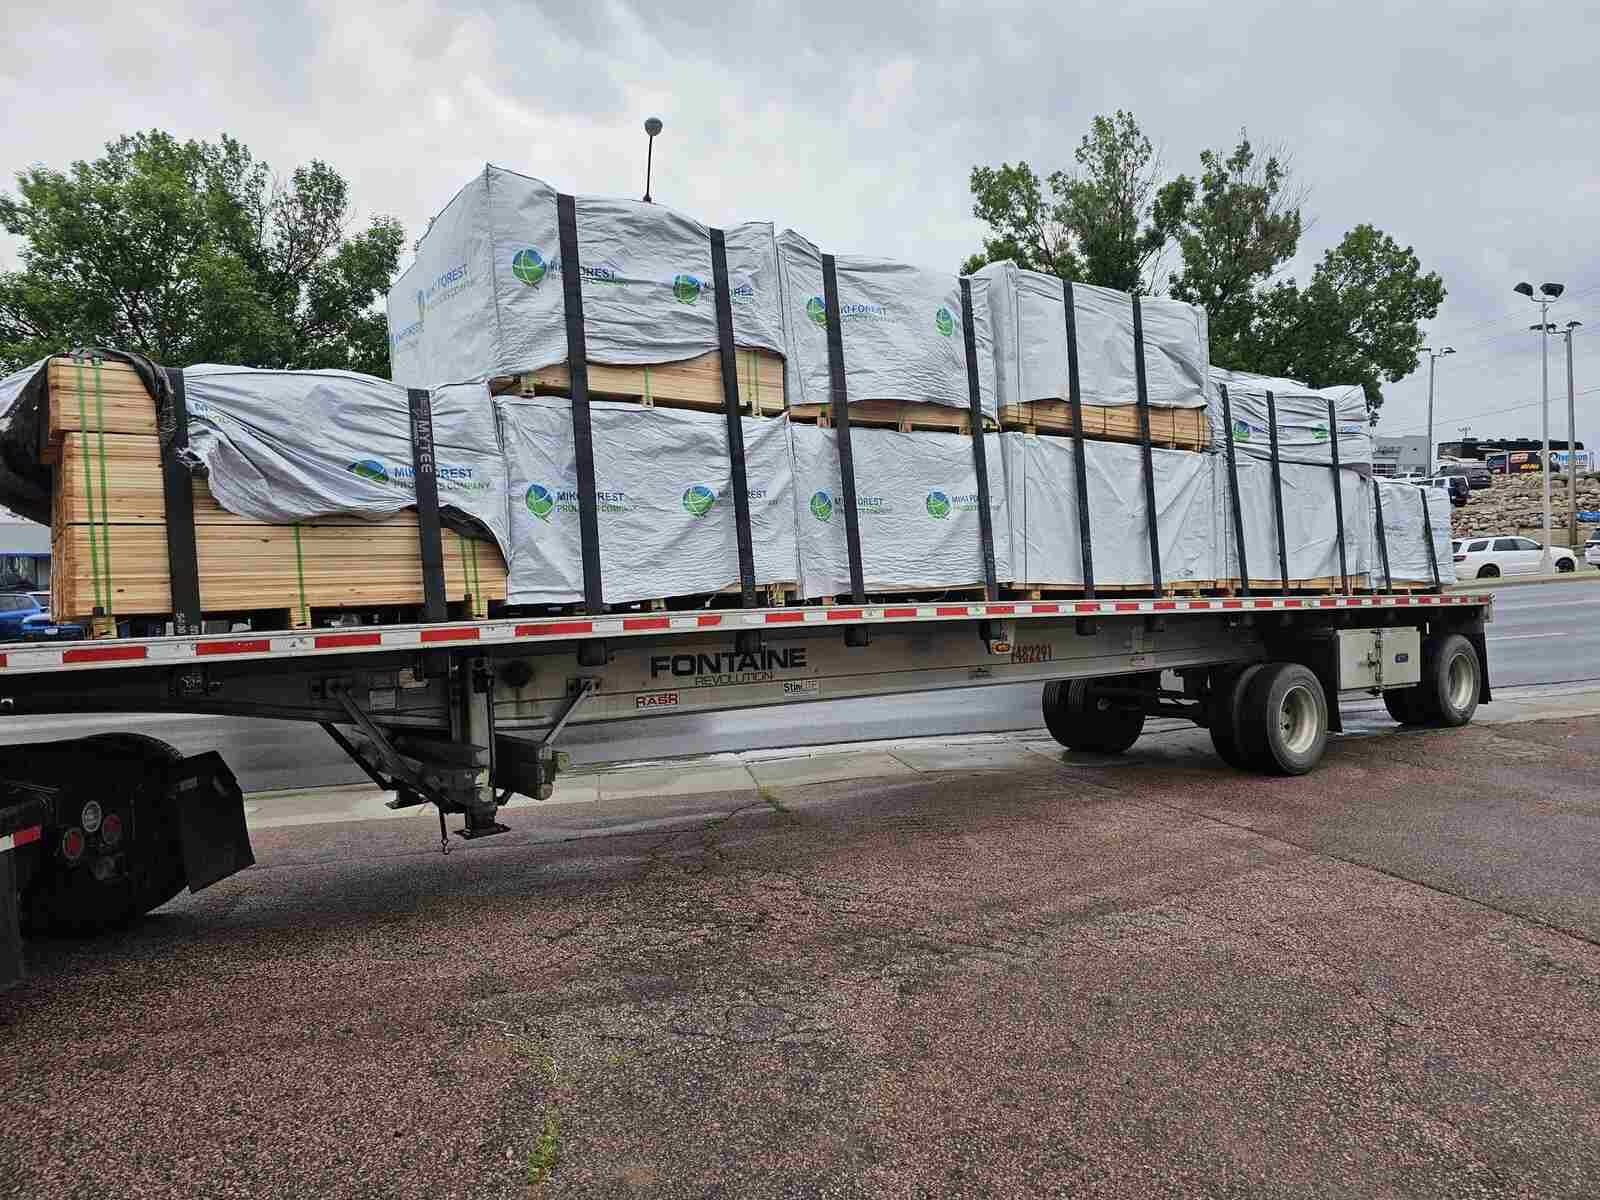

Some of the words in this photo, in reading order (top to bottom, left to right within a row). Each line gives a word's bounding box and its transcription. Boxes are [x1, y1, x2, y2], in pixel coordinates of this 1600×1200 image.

[416, 420, 433, 473] MYTEE
[651, 646, 807, 681] FONTAINE
[695, 670, 775, 688] REVOLUTION
